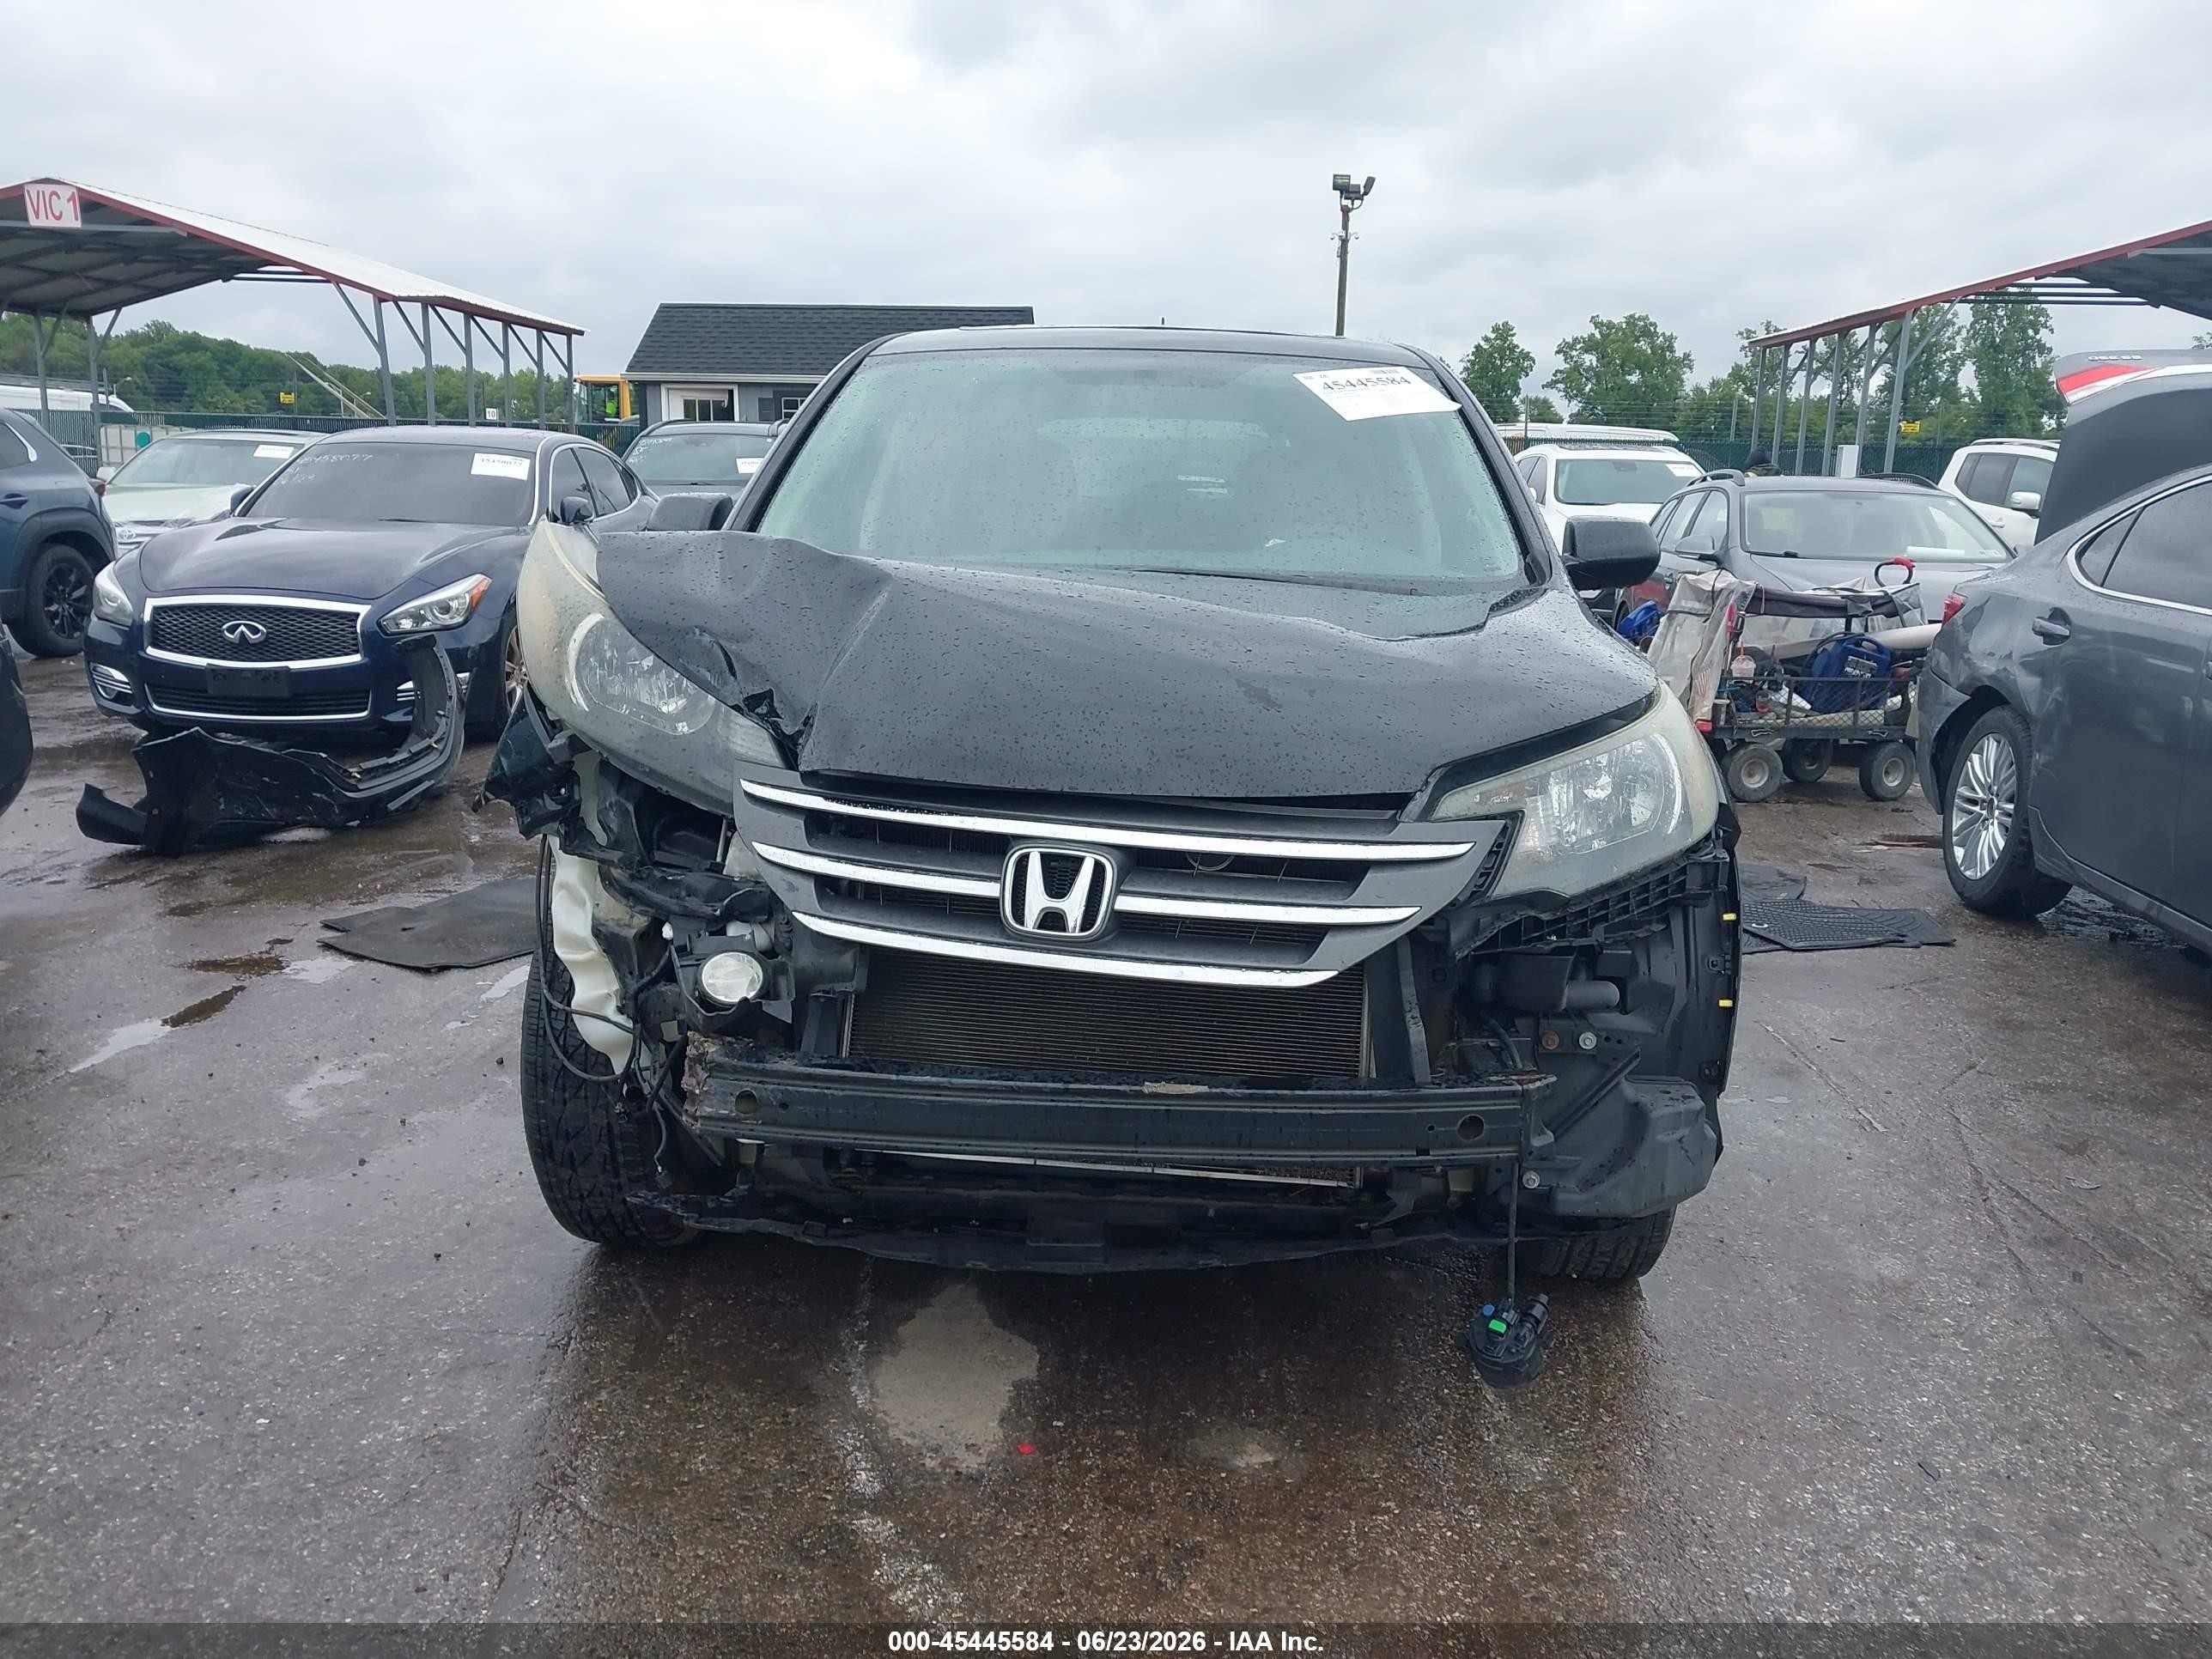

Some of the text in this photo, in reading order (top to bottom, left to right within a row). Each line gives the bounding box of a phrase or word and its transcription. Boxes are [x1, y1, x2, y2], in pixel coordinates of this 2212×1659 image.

[26, 189, 79, 222] VIC 1
[1322, 375, 1413, 392] 45445584
[487, 410, 496, 418] 10
